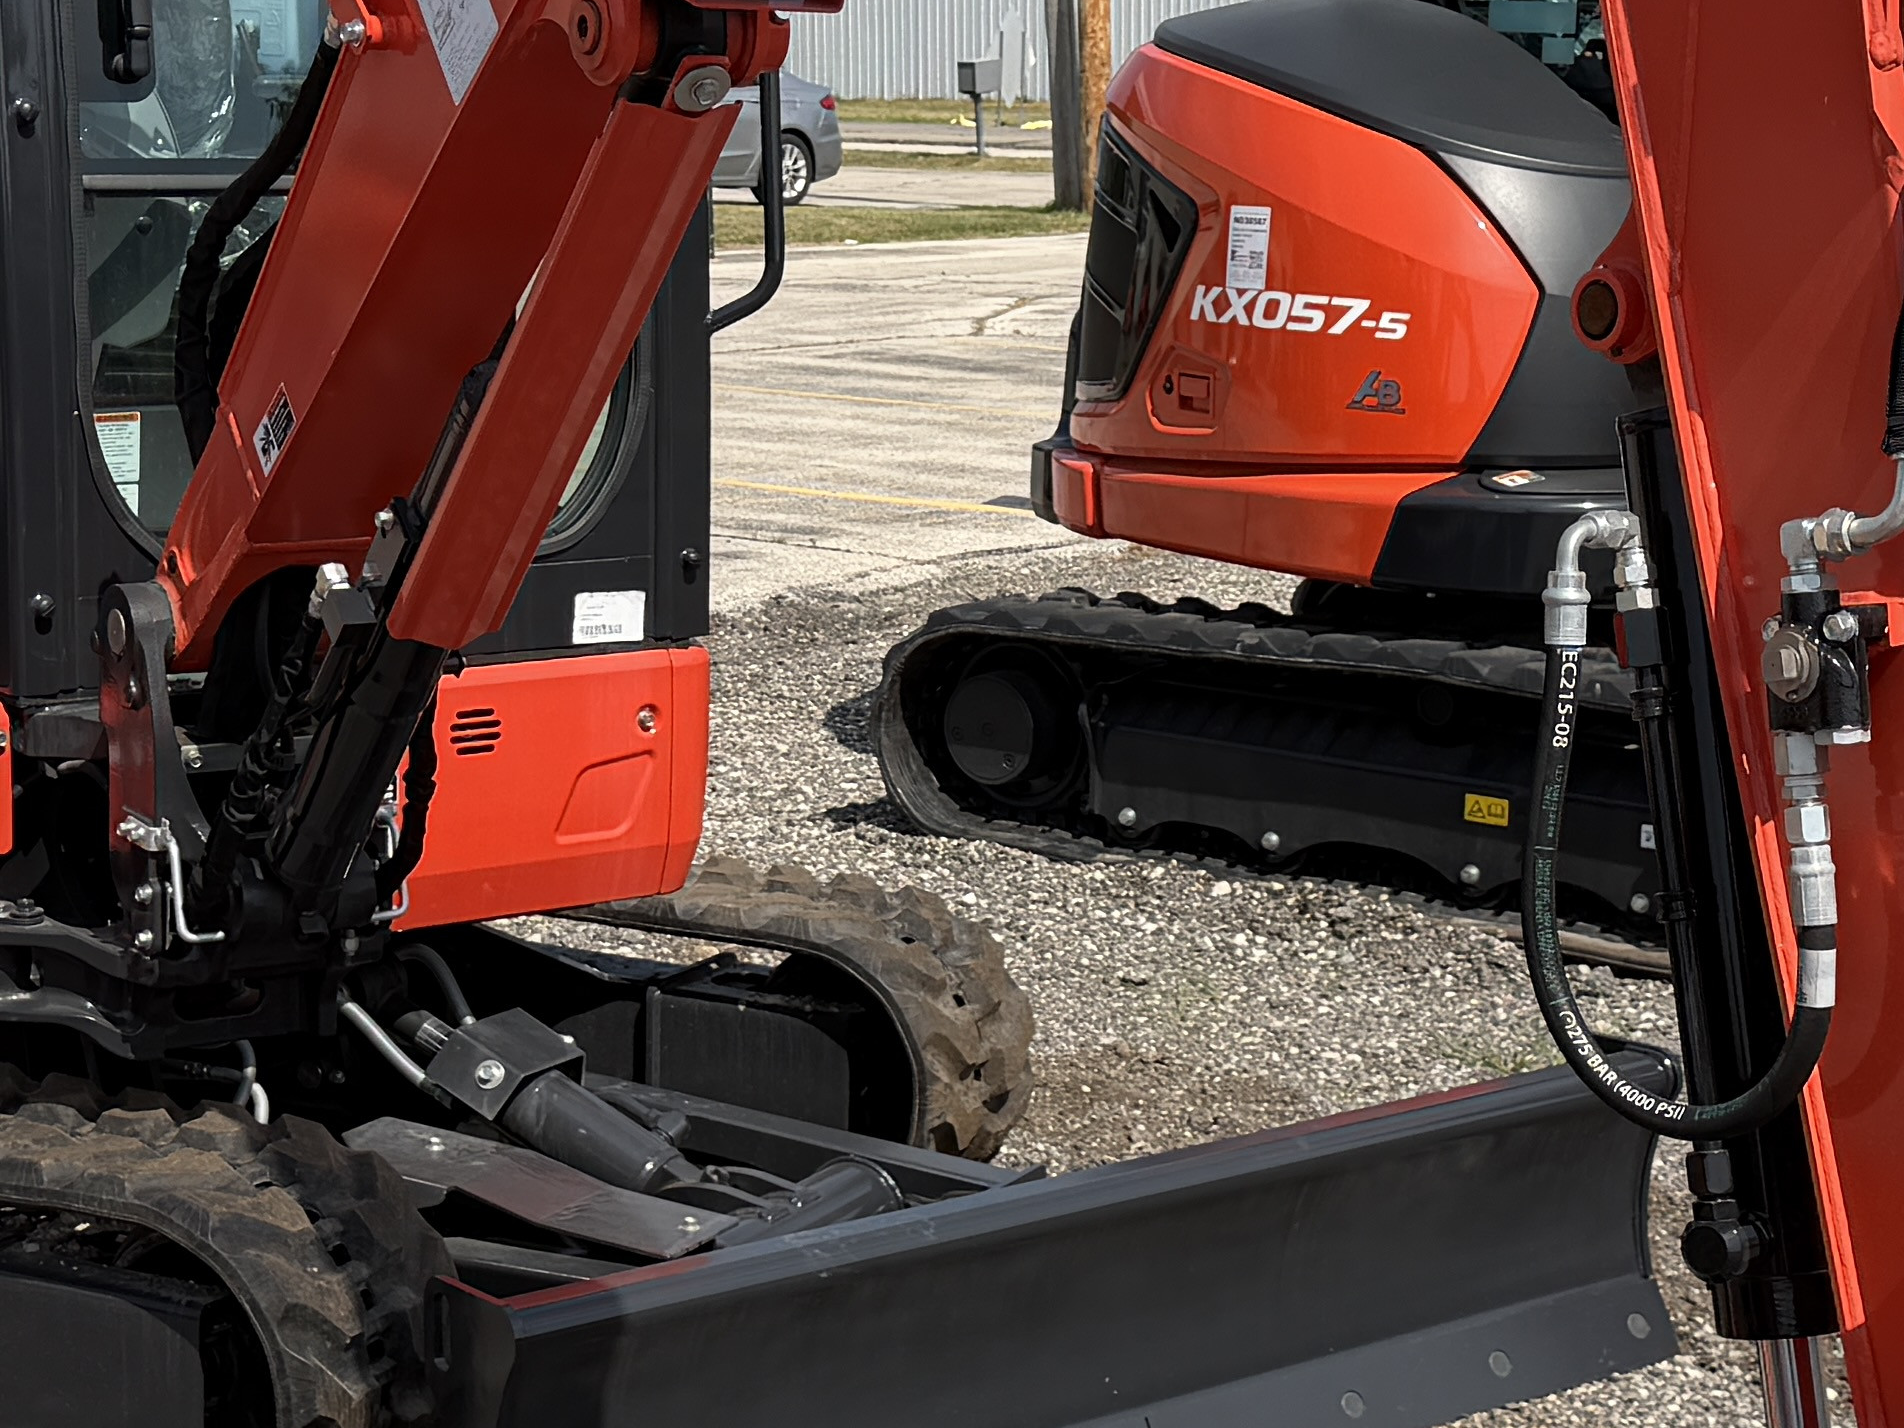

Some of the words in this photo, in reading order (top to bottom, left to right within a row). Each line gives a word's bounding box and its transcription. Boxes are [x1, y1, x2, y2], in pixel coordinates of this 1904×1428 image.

[1190, 285, 1411, 339] KX057-5
[1553, 650, 1578, 748] EC215-08
[1567, 1026, 1594, 1056] 275
[1587, 1054, 1618, 1086] BAR
[1613, 1080, 1656, 1111] (4000
